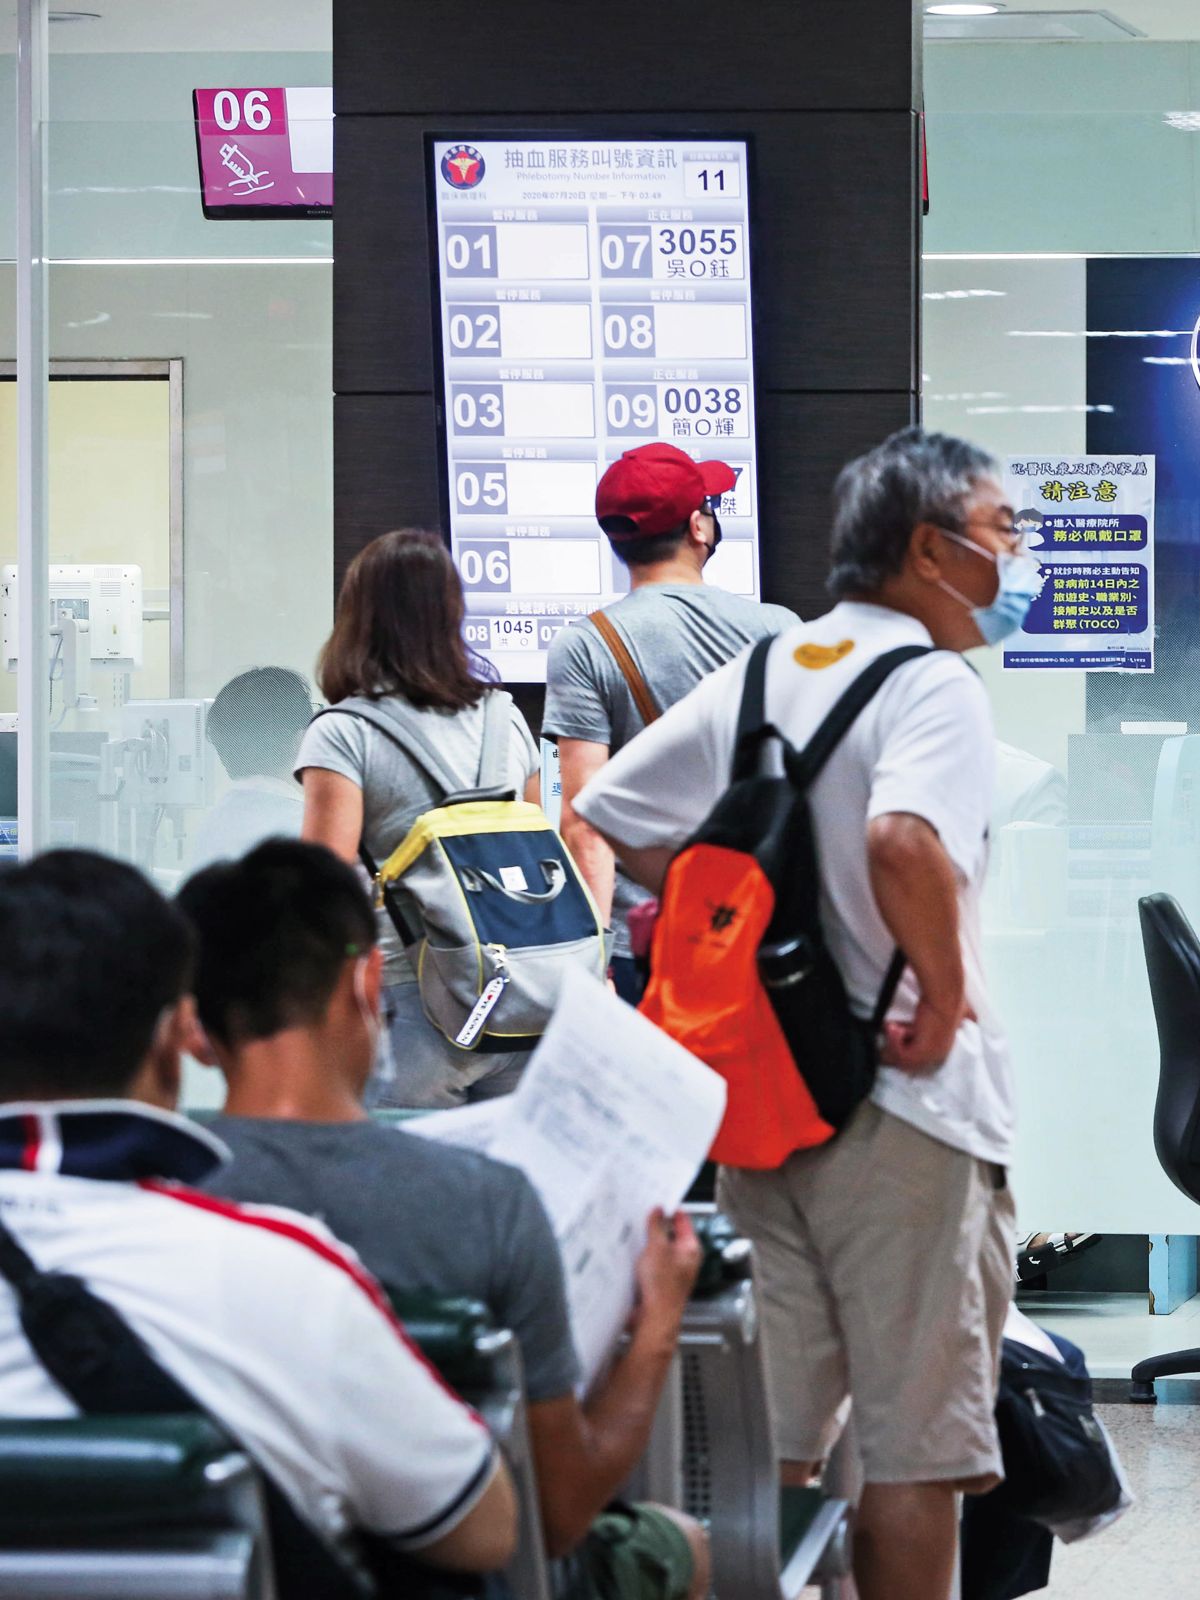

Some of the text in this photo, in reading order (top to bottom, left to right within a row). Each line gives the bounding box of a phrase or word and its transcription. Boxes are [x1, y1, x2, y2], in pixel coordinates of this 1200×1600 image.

[213, 90, 272, 131] 06
[504, 148, 678, 169] 抽血服務叫號資訊
[573, 172, 610, 181] Number
[612, 172, 667, 181] Information
[698, 169, 724, 191] 11
[447, 235, 491, 270] 01
[601, 235, 650, 270] 07
[659, 229, 738, 255] 3055
[450, 314, 499, 349] 02
[604, 314, 654, 350] 08
[454, 393, 502, 428] 03
[607, 394, 656, 428] 09
[664, 388, 741, 414] 0038
[456, 473, 506, 506] 05
[1040, 480, 1117, 502] 請注意
[1053, 518, 1120, 528] 進入醫療院所
[1053, 530, 1142, 542] 務必佩戴口罩
[460, 550, 510, 584] 06
[1053, 567, 1140, 576] 就診時務必主動告知
[1053, 606, 1138, 616] 接觸史以及是否
[465, 626, 488, 642] 08
[494, 620, 533, 634] 1045
